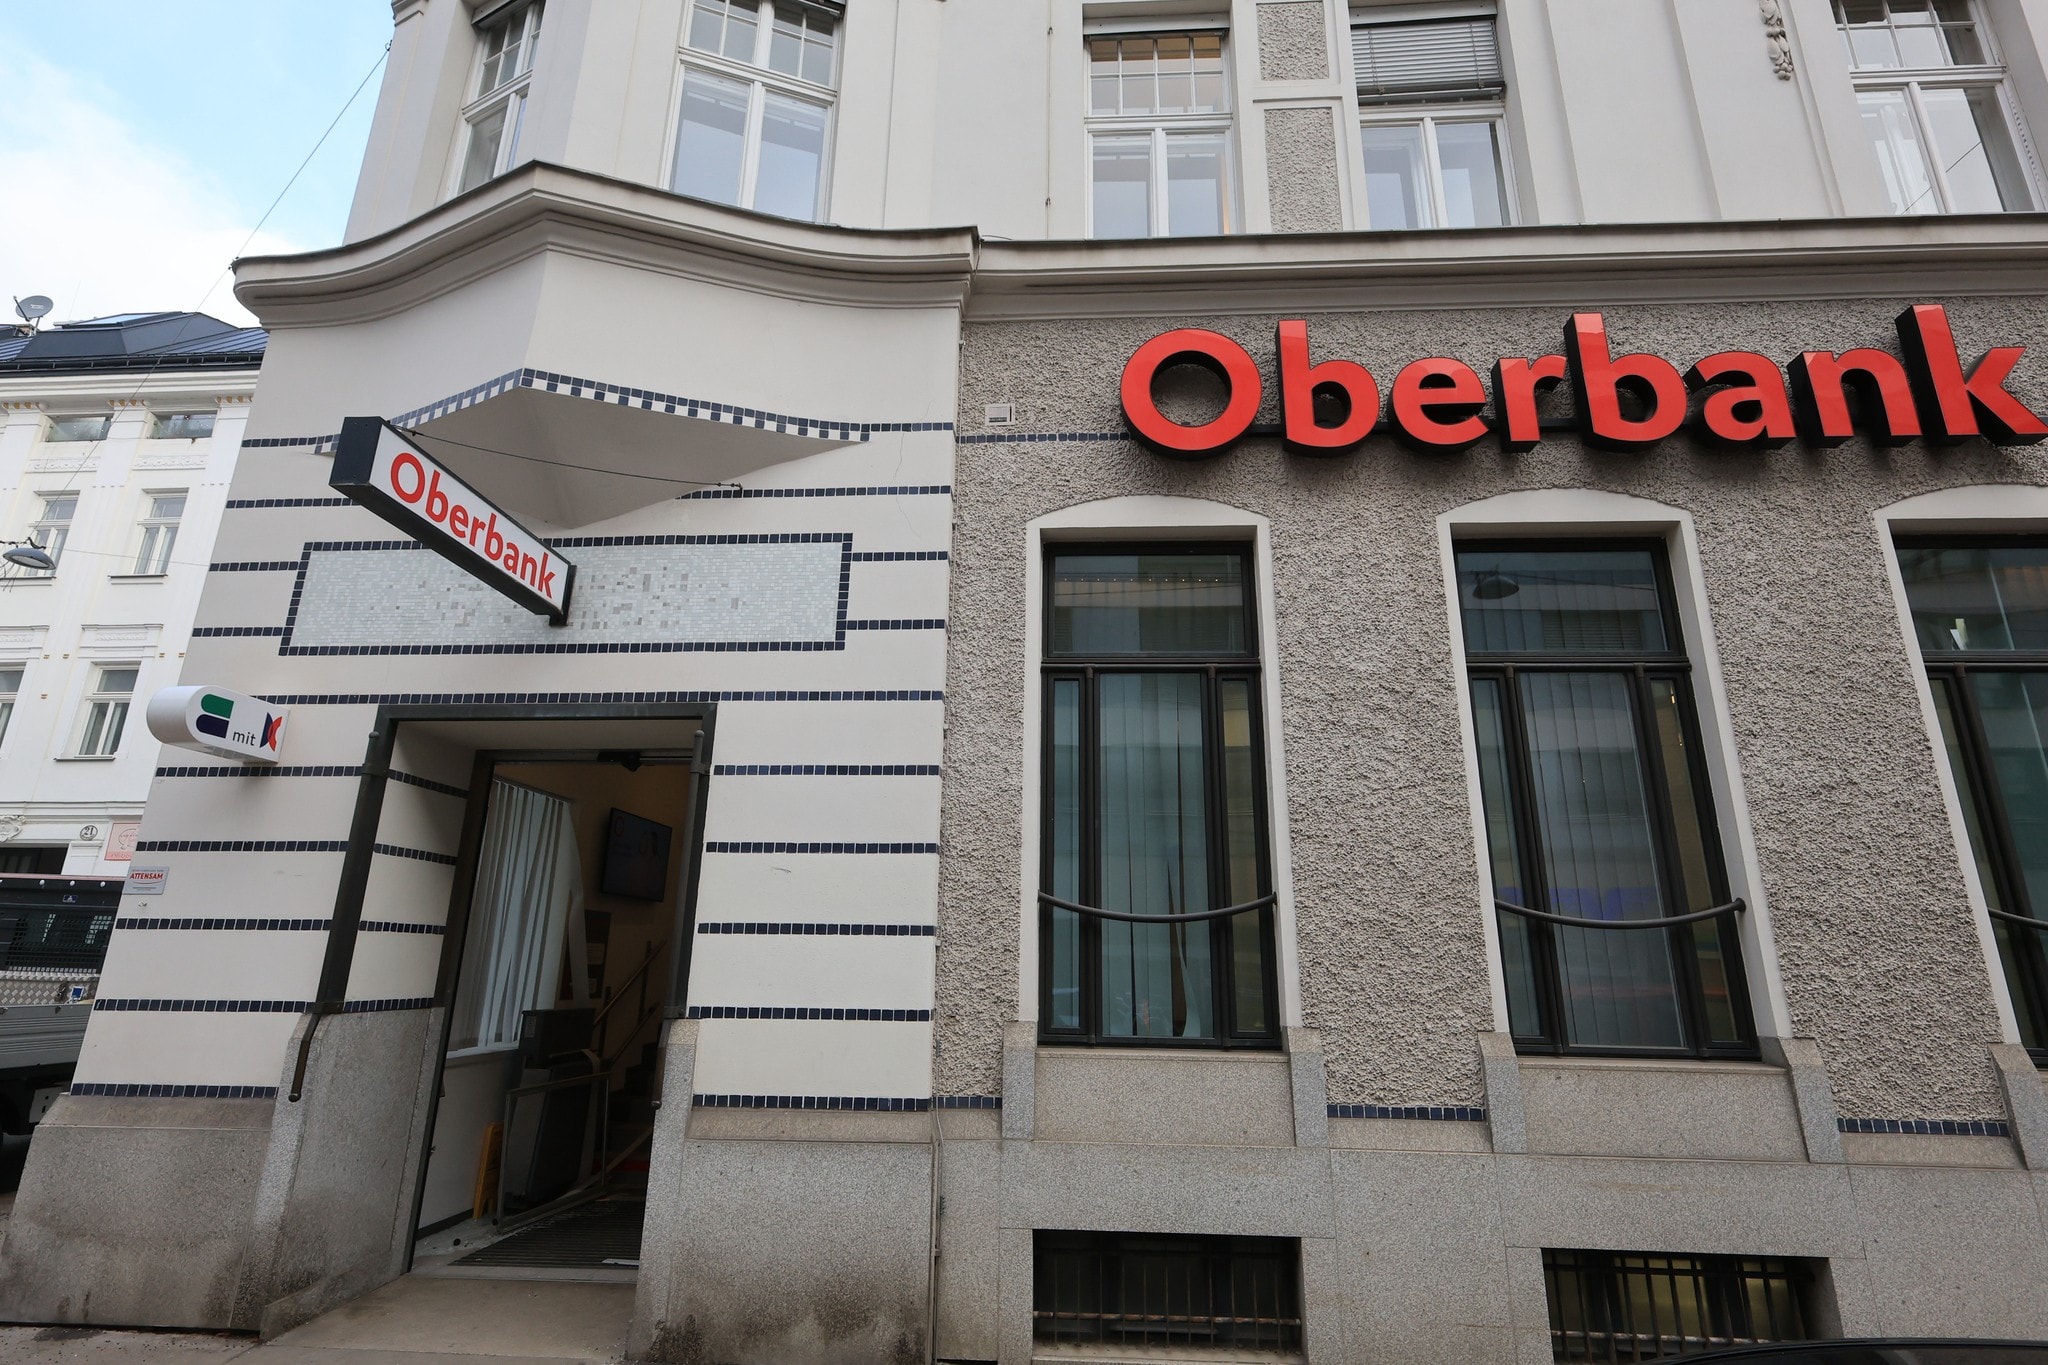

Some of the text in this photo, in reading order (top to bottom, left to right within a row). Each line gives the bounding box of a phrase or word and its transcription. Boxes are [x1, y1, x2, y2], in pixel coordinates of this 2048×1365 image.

[1119, 303, 2048, 451] Oberbank
[390, 452, 556, 599] Oberbank
[232, 731, 256, 746] mit
[130, 872, 163, 880] ATTENSAM
